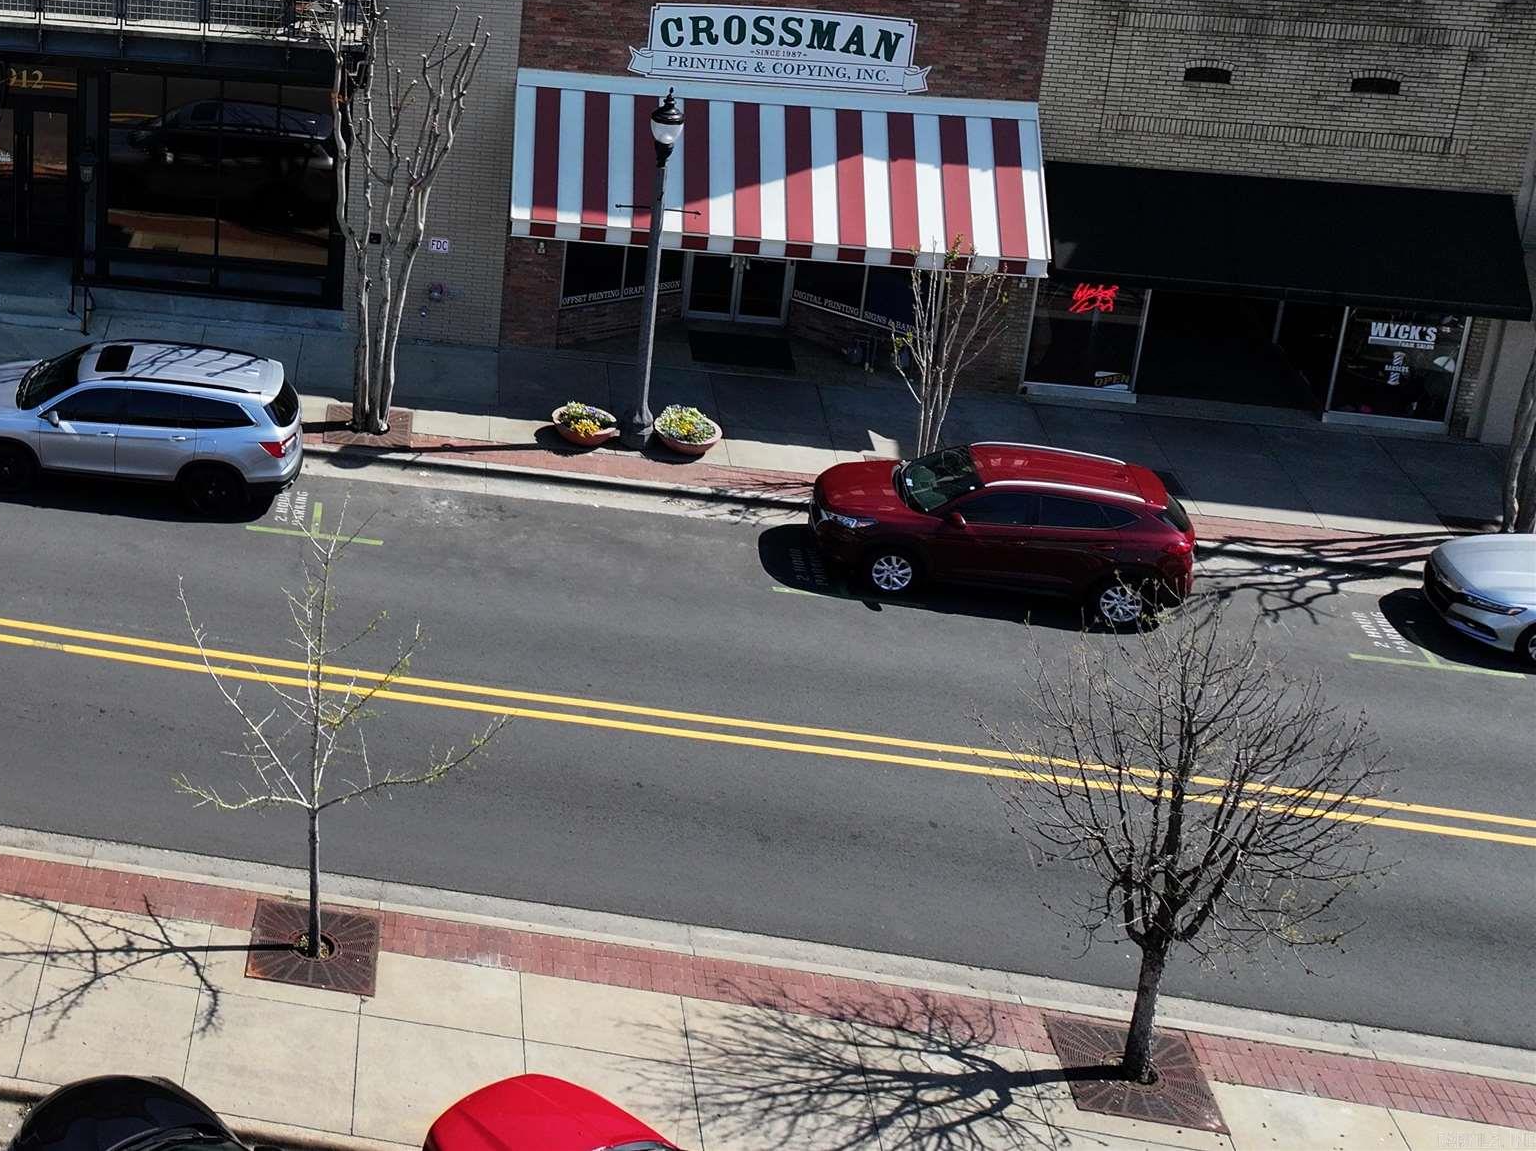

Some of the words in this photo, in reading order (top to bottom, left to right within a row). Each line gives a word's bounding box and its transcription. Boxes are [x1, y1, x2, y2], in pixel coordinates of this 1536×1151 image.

[660, 15, 904, 62] CROSSMAN
[755, 49, 781, 57] SINCE
[667, 55, 748, 72] PRINTING
[754, 63, 766, 73] &
[772, 63, 852, 81] COPYING,
[855, 68, 890, 82] INC.
[432, 240, 448, 251] FDC
[561, 293, 587, 306] OFFSET
[588, 290, 621, 302] PRINTING
[793, 289, 823, 305] DIGITAL
[823, 298, 859, 316] PRINTING
[864, 310, 888, 325] SIGNS
[1370, 322, 1438, 341] WYCK'S
[1094, 374, 1130, 387] OPEN
[1351, 611, 1383, 639] HOUR
[1374, 640, 1392, 649] 2
